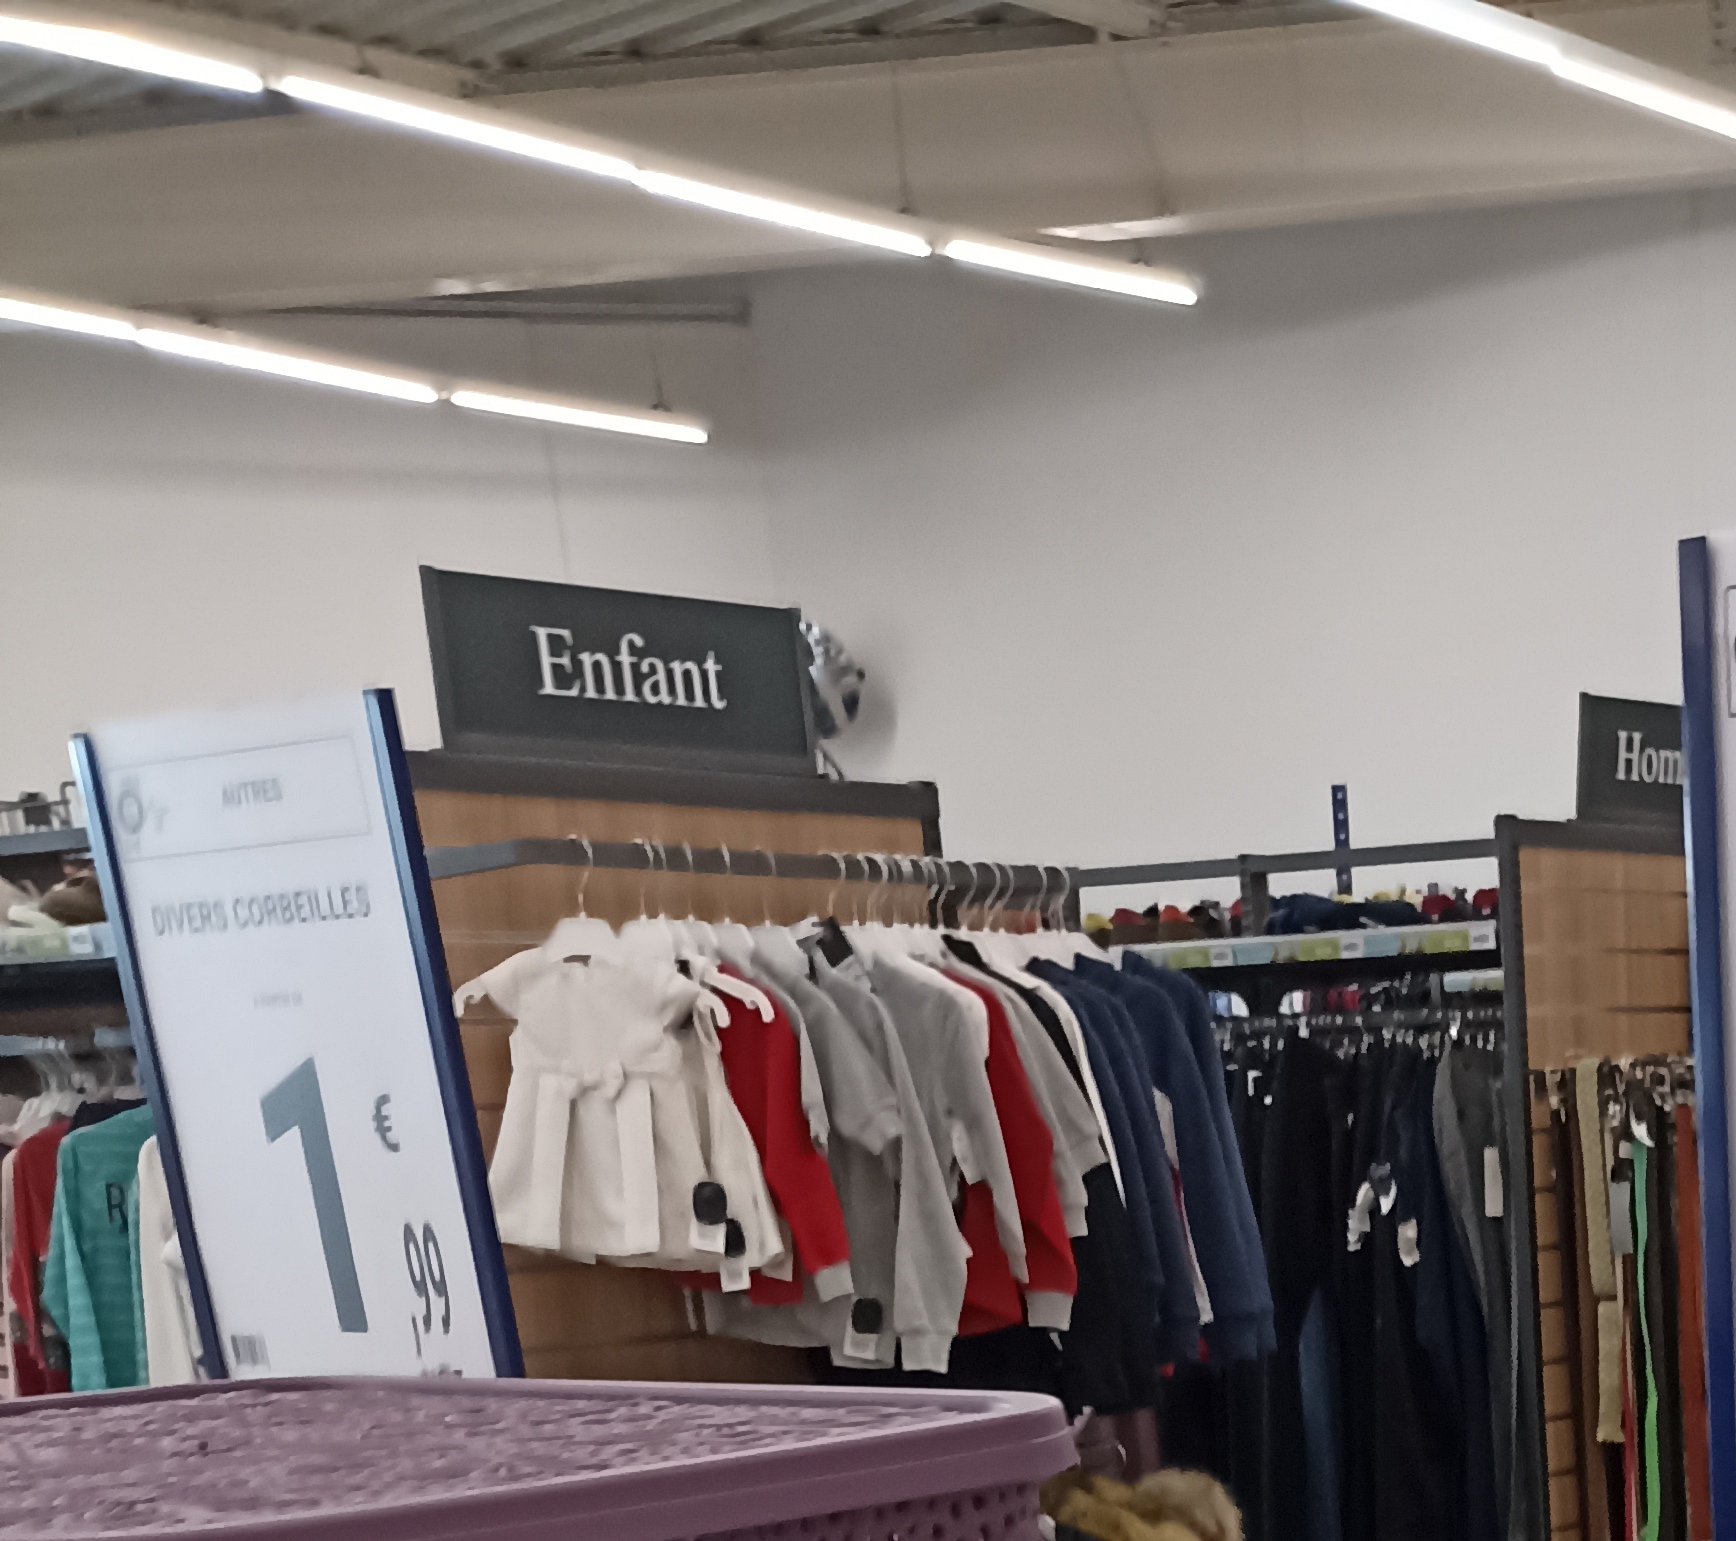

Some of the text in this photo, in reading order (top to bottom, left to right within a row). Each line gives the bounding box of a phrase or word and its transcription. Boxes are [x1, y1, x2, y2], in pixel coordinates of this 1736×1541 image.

[529, 624, 727, 712] Enfant
[222, 777, 283, 809] AUTRES
[152, 884, 372, 937] DIVERS CORBEILLES
[259, 1056, 368, 1333] 1
